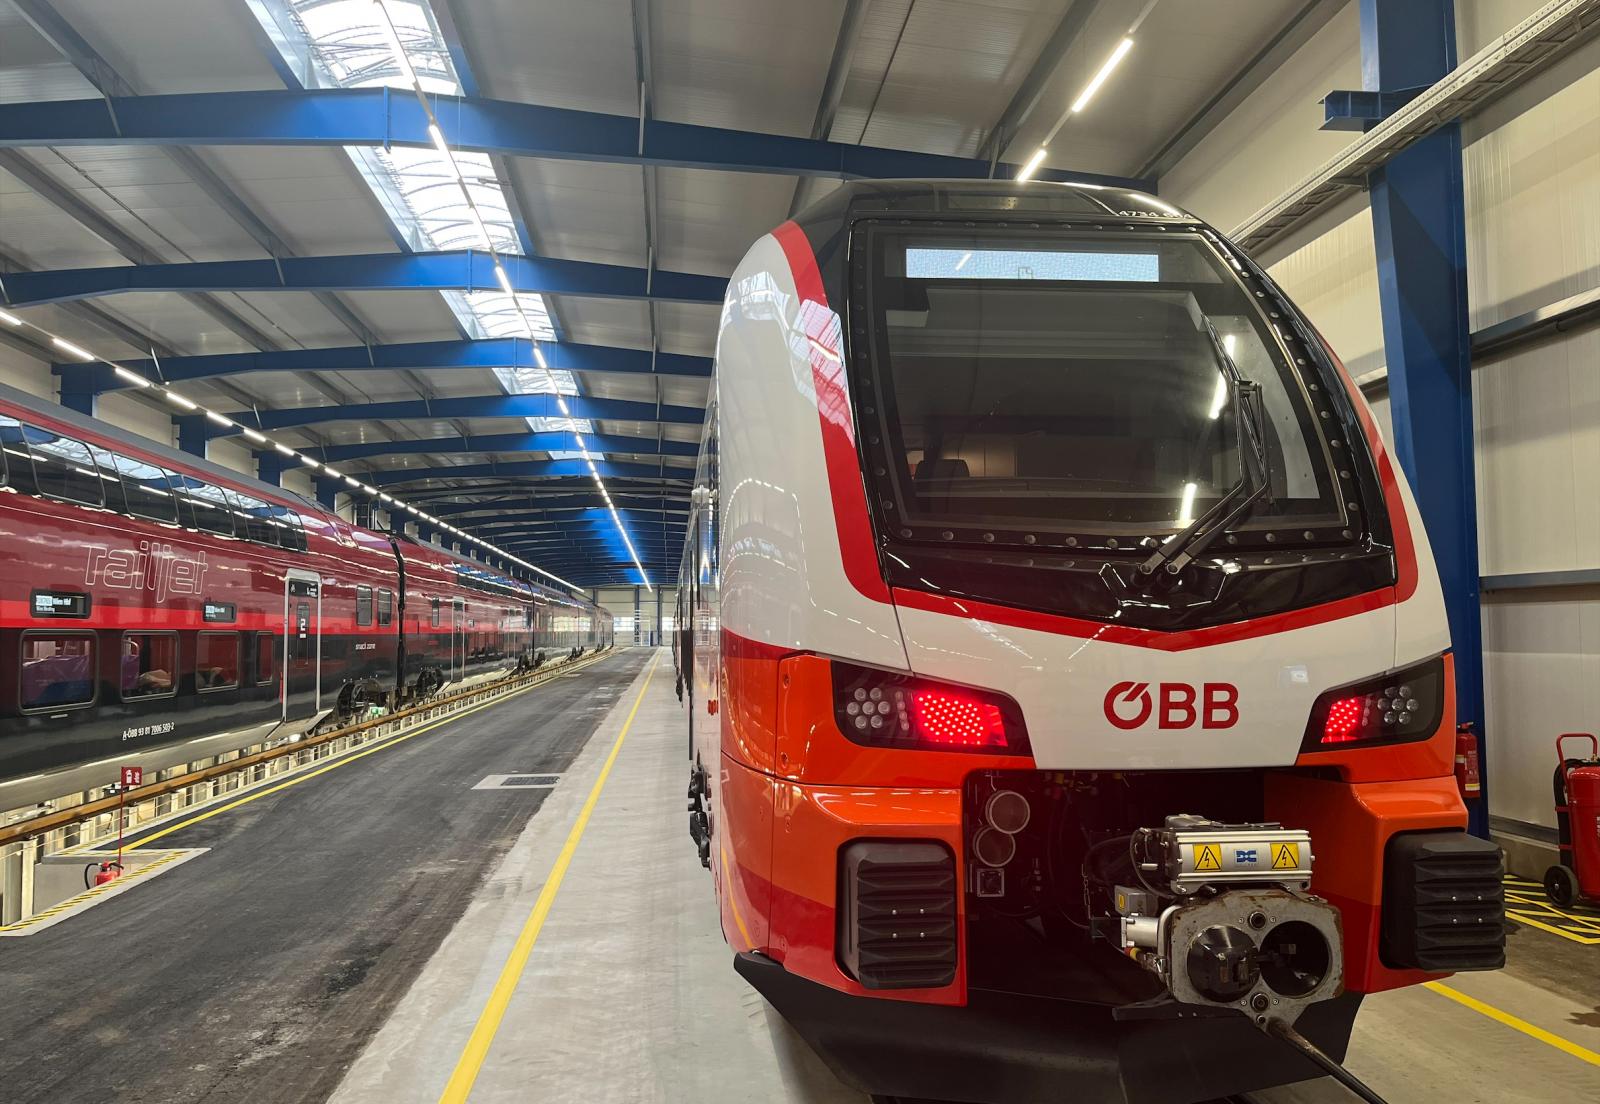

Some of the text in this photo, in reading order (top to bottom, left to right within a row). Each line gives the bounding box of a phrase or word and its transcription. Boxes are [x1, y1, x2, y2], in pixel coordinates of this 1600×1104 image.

[85, 540, 208, 603] railjet
[300, 618, 306, 631] 2
[1104, 681, 1239, 730] ÖBB
